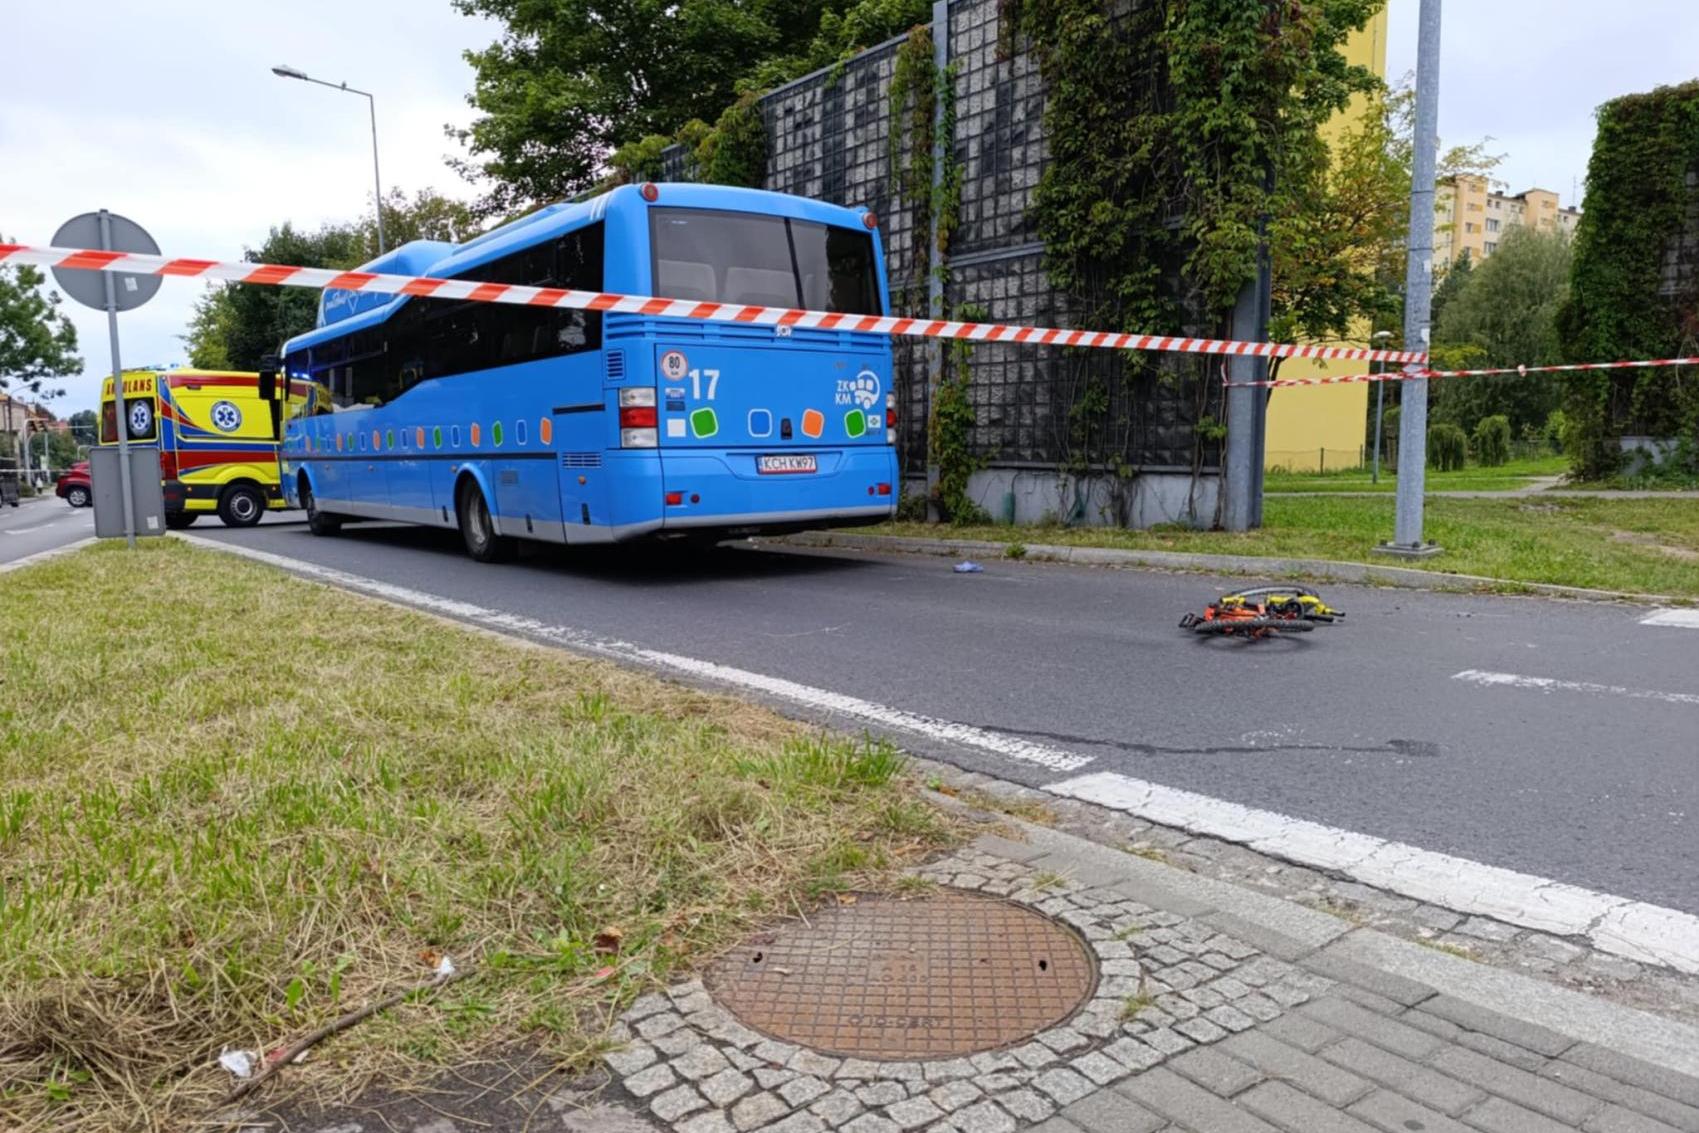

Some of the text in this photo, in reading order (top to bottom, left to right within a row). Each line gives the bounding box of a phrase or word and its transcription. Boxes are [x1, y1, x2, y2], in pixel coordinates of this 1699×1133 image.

[668, 356, 681, 369] 80
[106, 378, 152, 396] AULANS
[688, 369, 720, 400] 17
[836, 380, 850, 392] ZK
[835, 393, 851, 405] KM
[764, 456, 814, 469] KCH KW97
